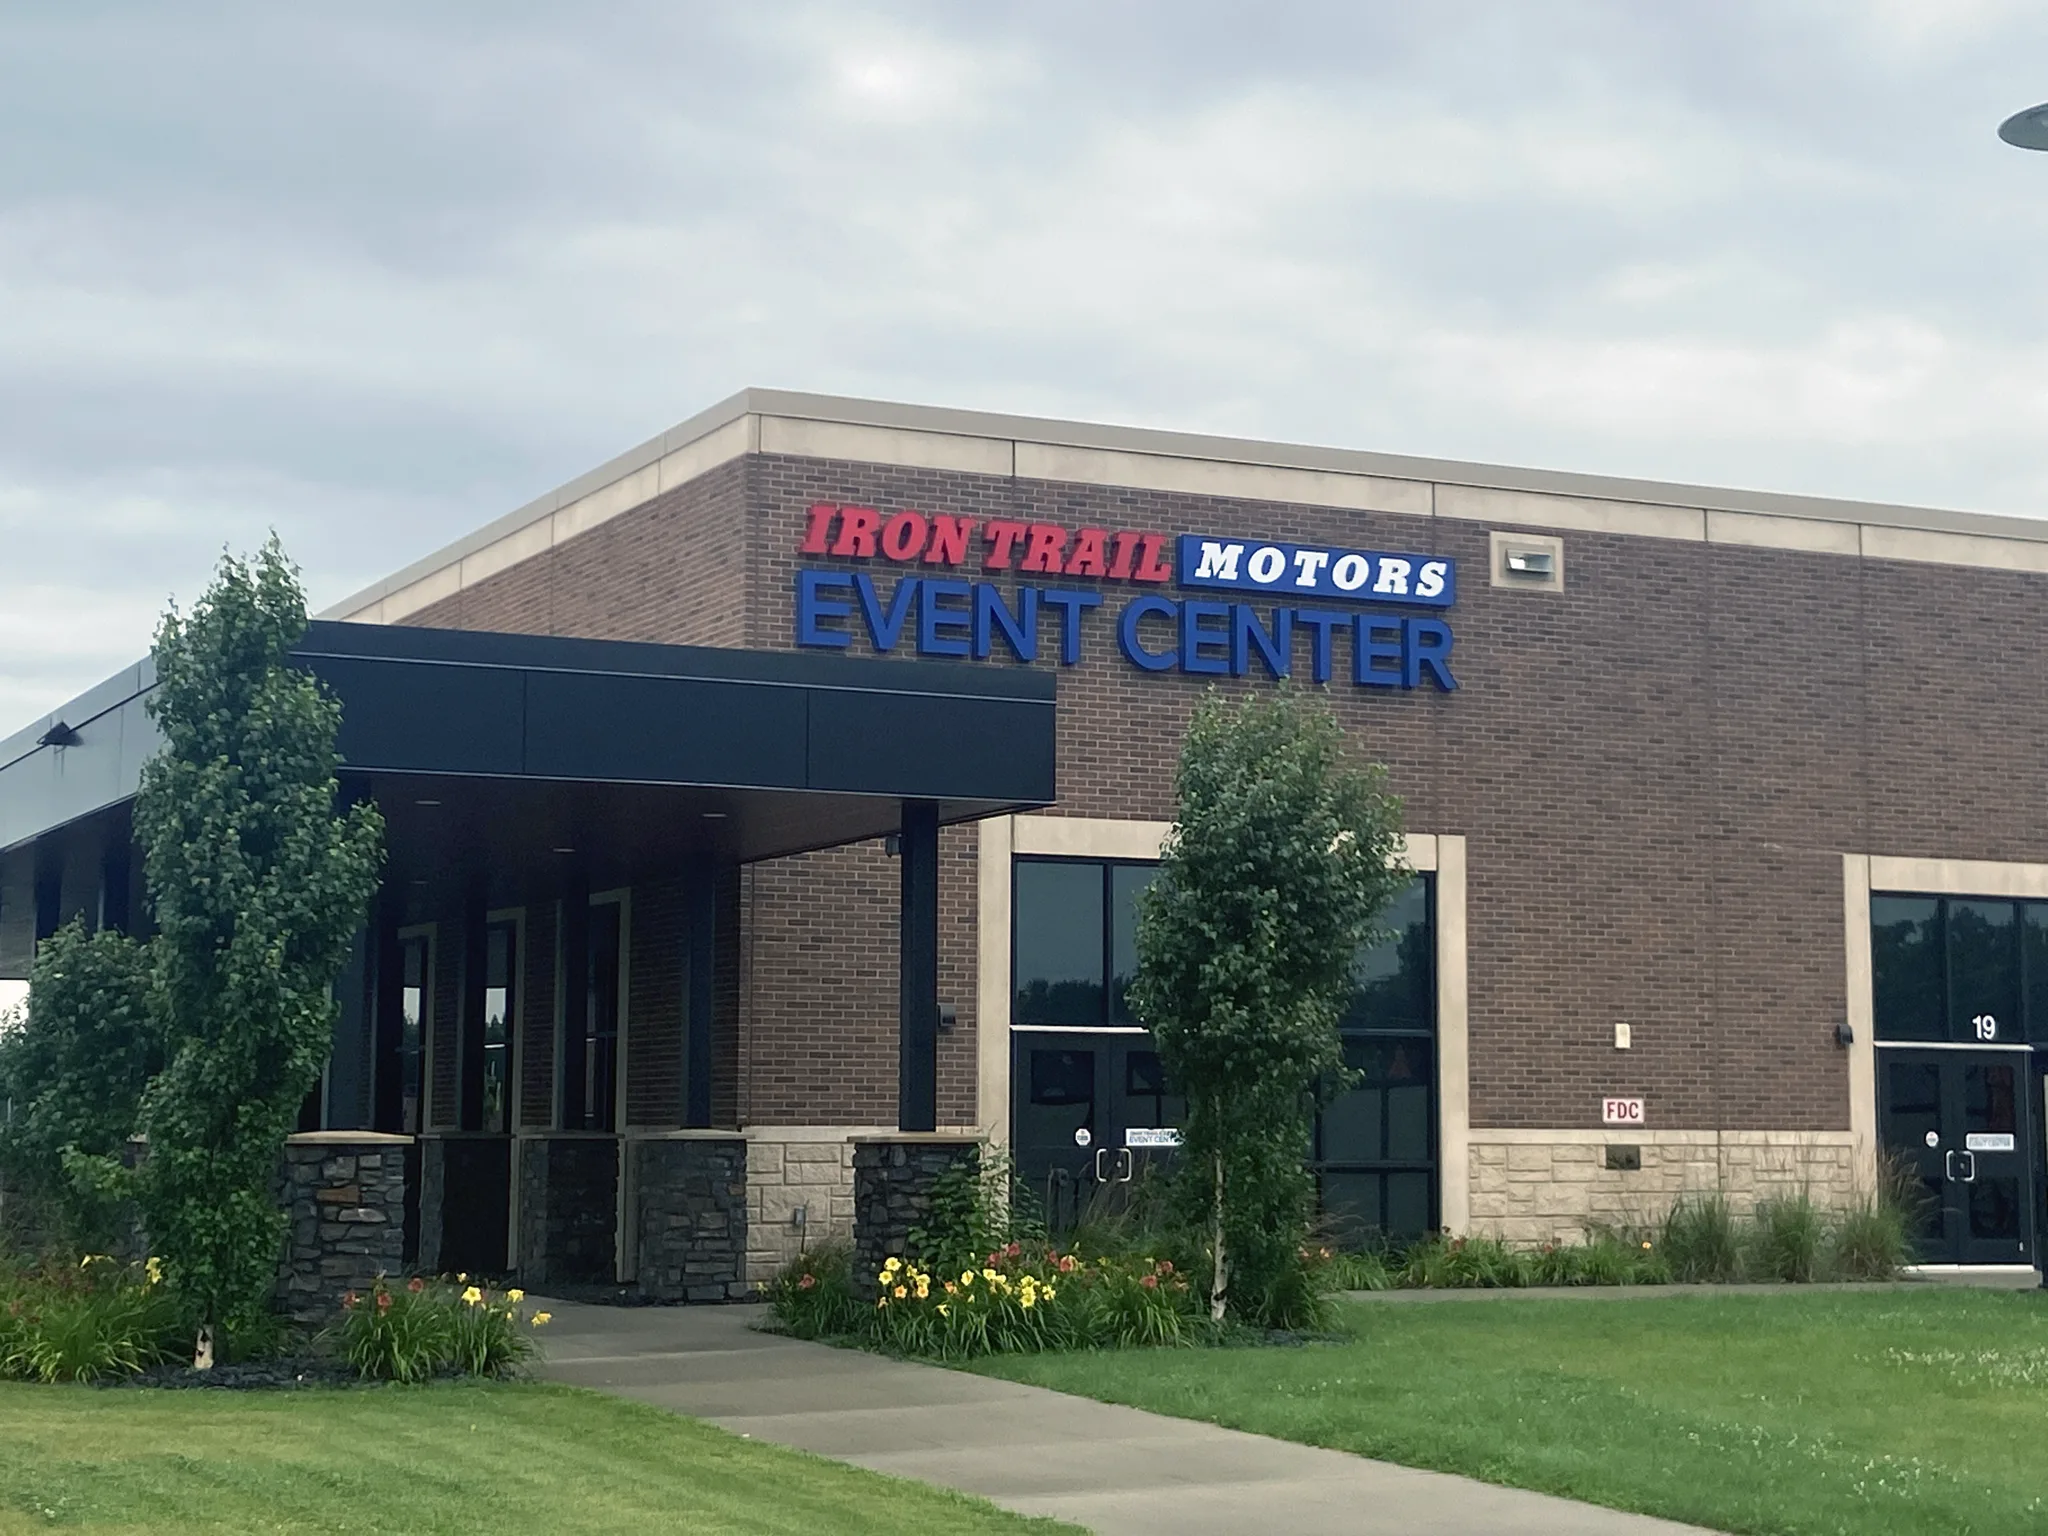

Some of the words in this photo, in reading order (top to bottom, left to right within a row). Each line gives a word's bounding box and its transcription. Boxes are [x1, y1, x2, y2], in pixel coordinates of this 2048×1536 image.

[799, 503, 977, 566] IRON
[982, 520, 1172, 583] TRAIL
[1194, 541, 1447, 597] MOTORS
[796, 569, 1103, 666] EVENT
[1118, 596, 1458, 691] CENTER
[1972, 1014, 1996, 1040] 19
[1606, 1101, 1639, 1119] FDC
